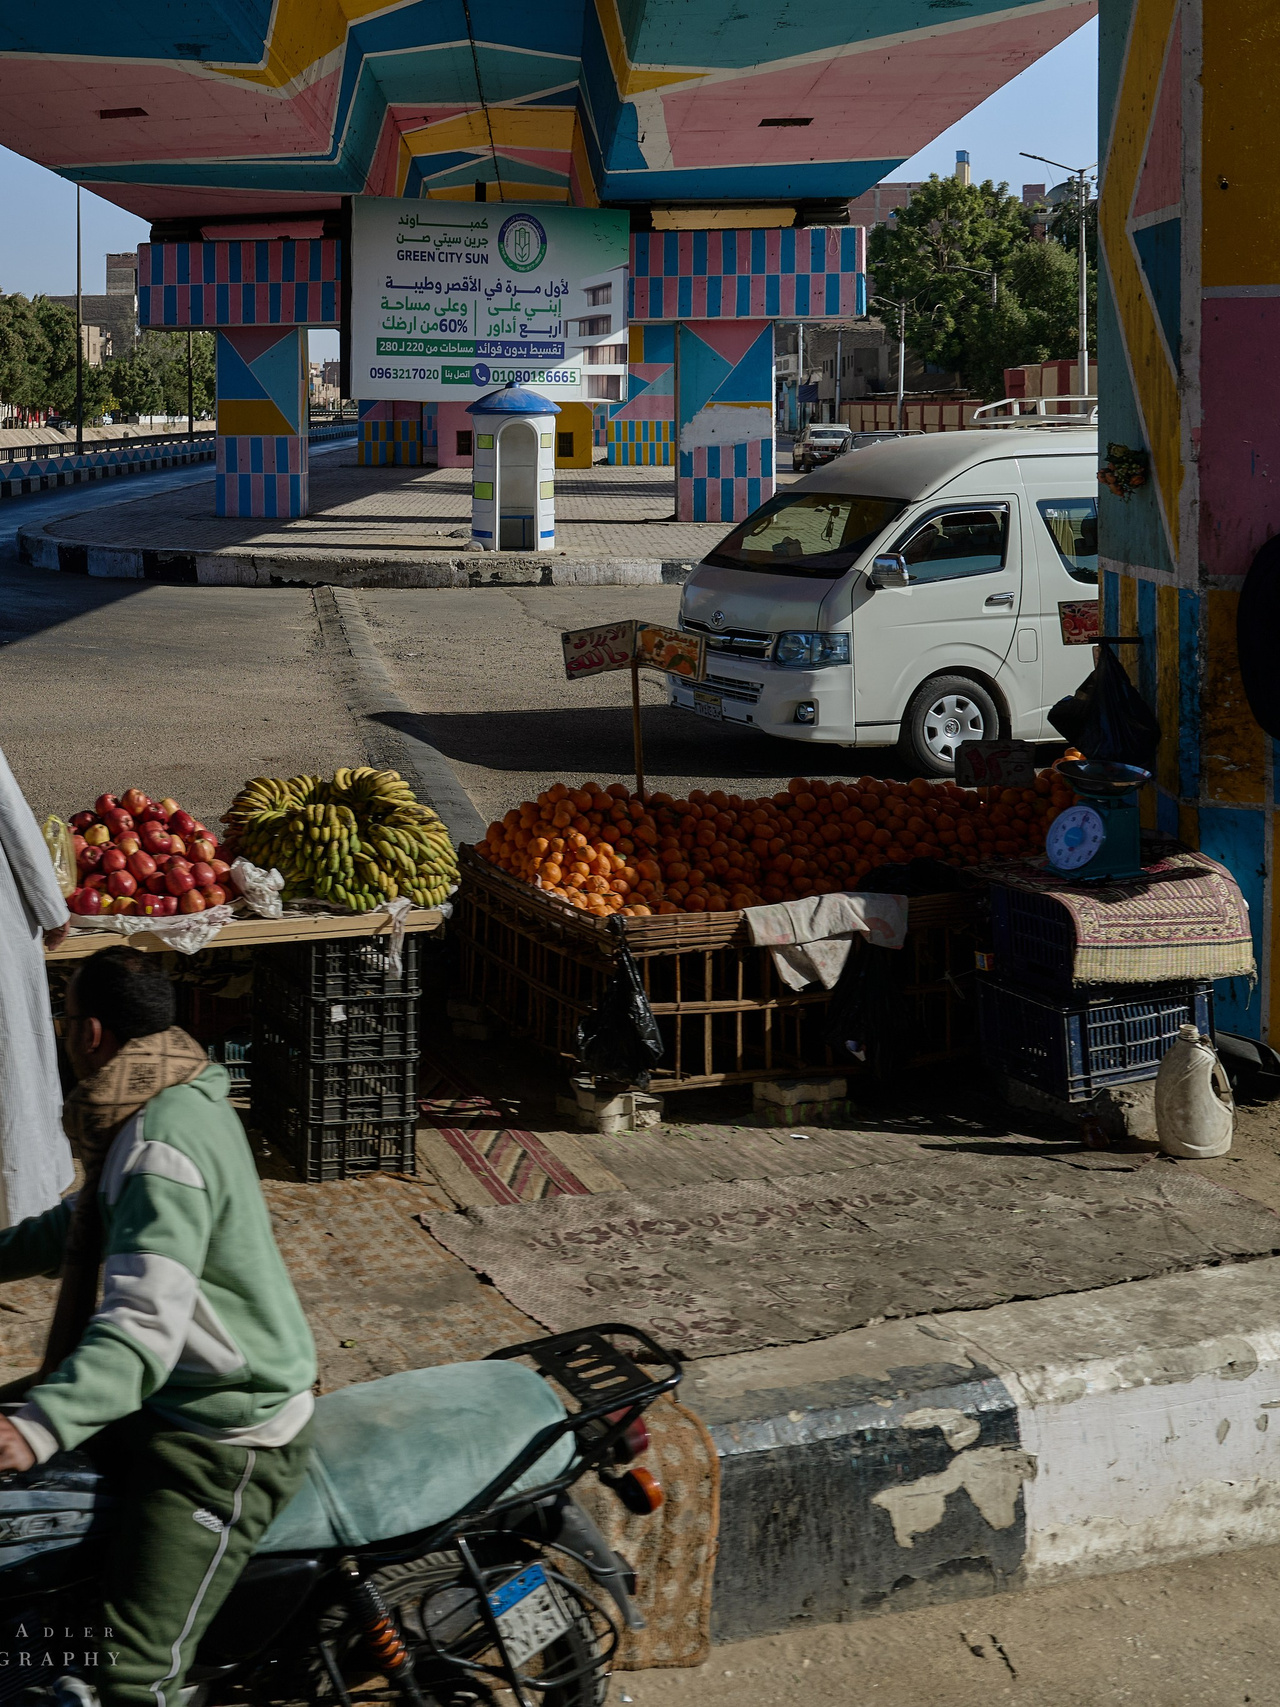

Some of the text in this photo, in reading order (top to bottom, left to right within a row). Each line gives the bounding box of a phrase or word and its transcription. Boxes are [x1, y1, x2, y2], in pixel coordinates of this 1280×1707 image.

[398, 213, 489, 232] كمباوند
[396, 233, 431, 244] صن
[433, 233, 462, 251] سيتي
[464, 236, 489, 249] جرين
[397, 249, 436, 262] GREEN
[438, 251, 463, 263] CITY
[465, 253, 489, 265] SUN
[385, 275, 570, 301] لأول مرة في الأقصر وطيبة
[380, 296, 468, 317] وعلى مساحة
[487, 297, 562, 322] إبني على
[382, 315, 417, 335] ارضك
[486, 315, 562, 339] اربع أداور
[380, 341, 398, 352] 280
[407, 342, 424, 352] 220
[425, 342, 439, 354] من
[440, 342, 474, 354] مساحات
[477, 342, 503, 356] فوائد
[503, 343, 527, 358] بدون
[529, 344, 562, 358] تقسيط
[369, 367, 439, 380] 0963217020
[453, 369, 470, 379] اتصل
[491, 369, 577, 383] 01080186665
